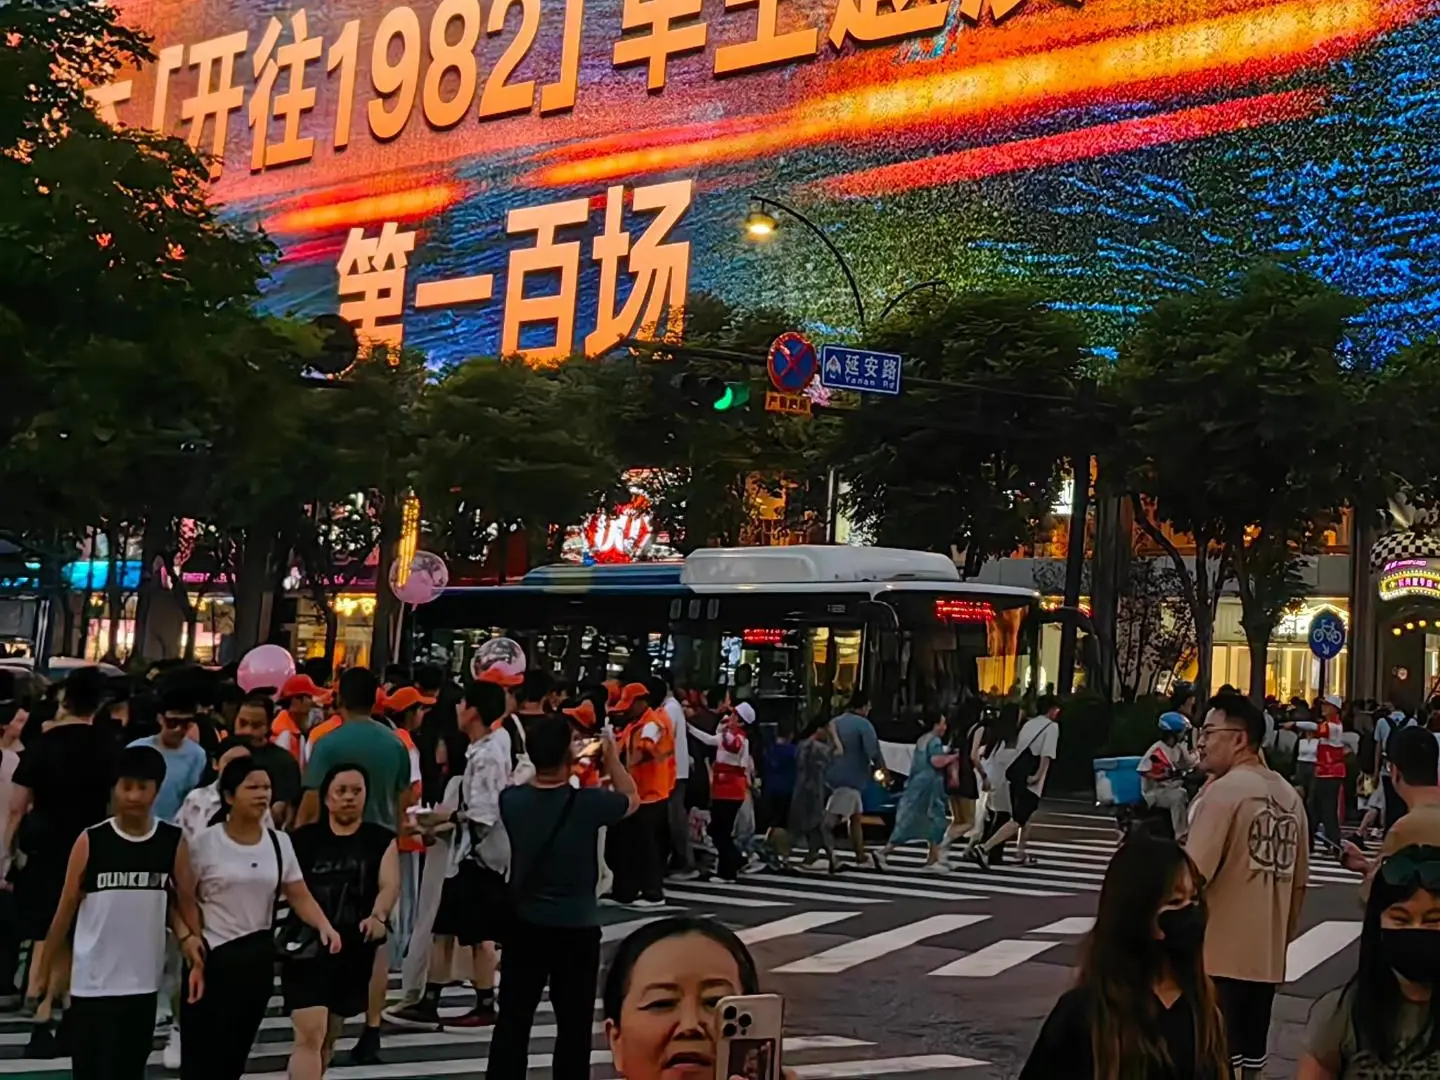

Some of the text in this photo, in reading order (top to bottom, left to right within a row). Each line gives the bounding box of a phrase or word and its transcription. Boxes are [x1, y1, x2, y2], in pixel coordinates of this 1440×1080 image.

[337, 178, 694, 366] 第一百场
[844, 354, 897, 381] 延安路
